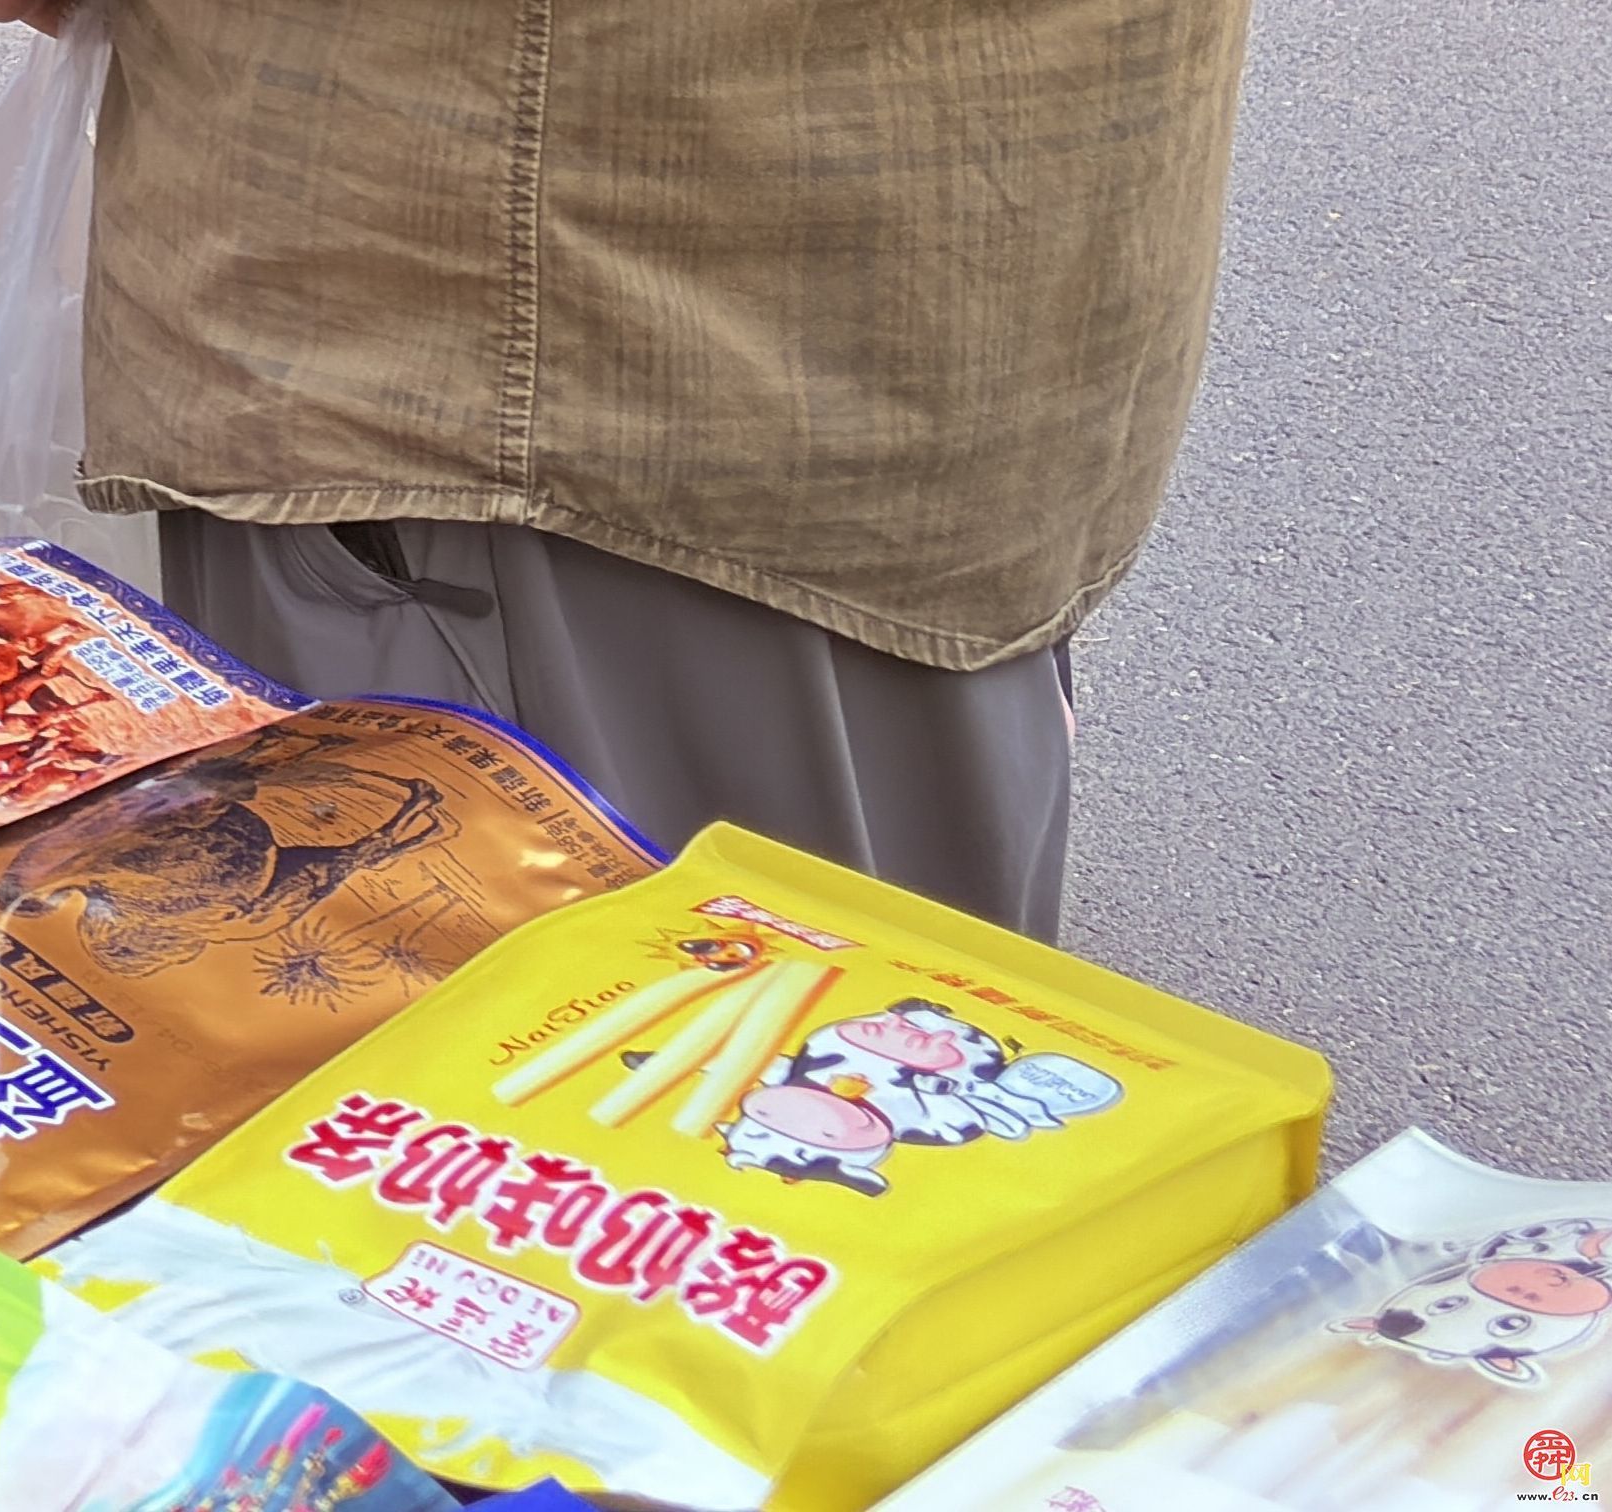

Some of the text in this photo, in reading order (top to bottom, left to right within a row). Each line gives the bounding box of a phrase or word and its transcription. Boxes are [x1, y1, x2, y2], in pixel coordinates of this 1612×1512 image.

[284, 1092, 832, 1350] 酸奶味奶条
